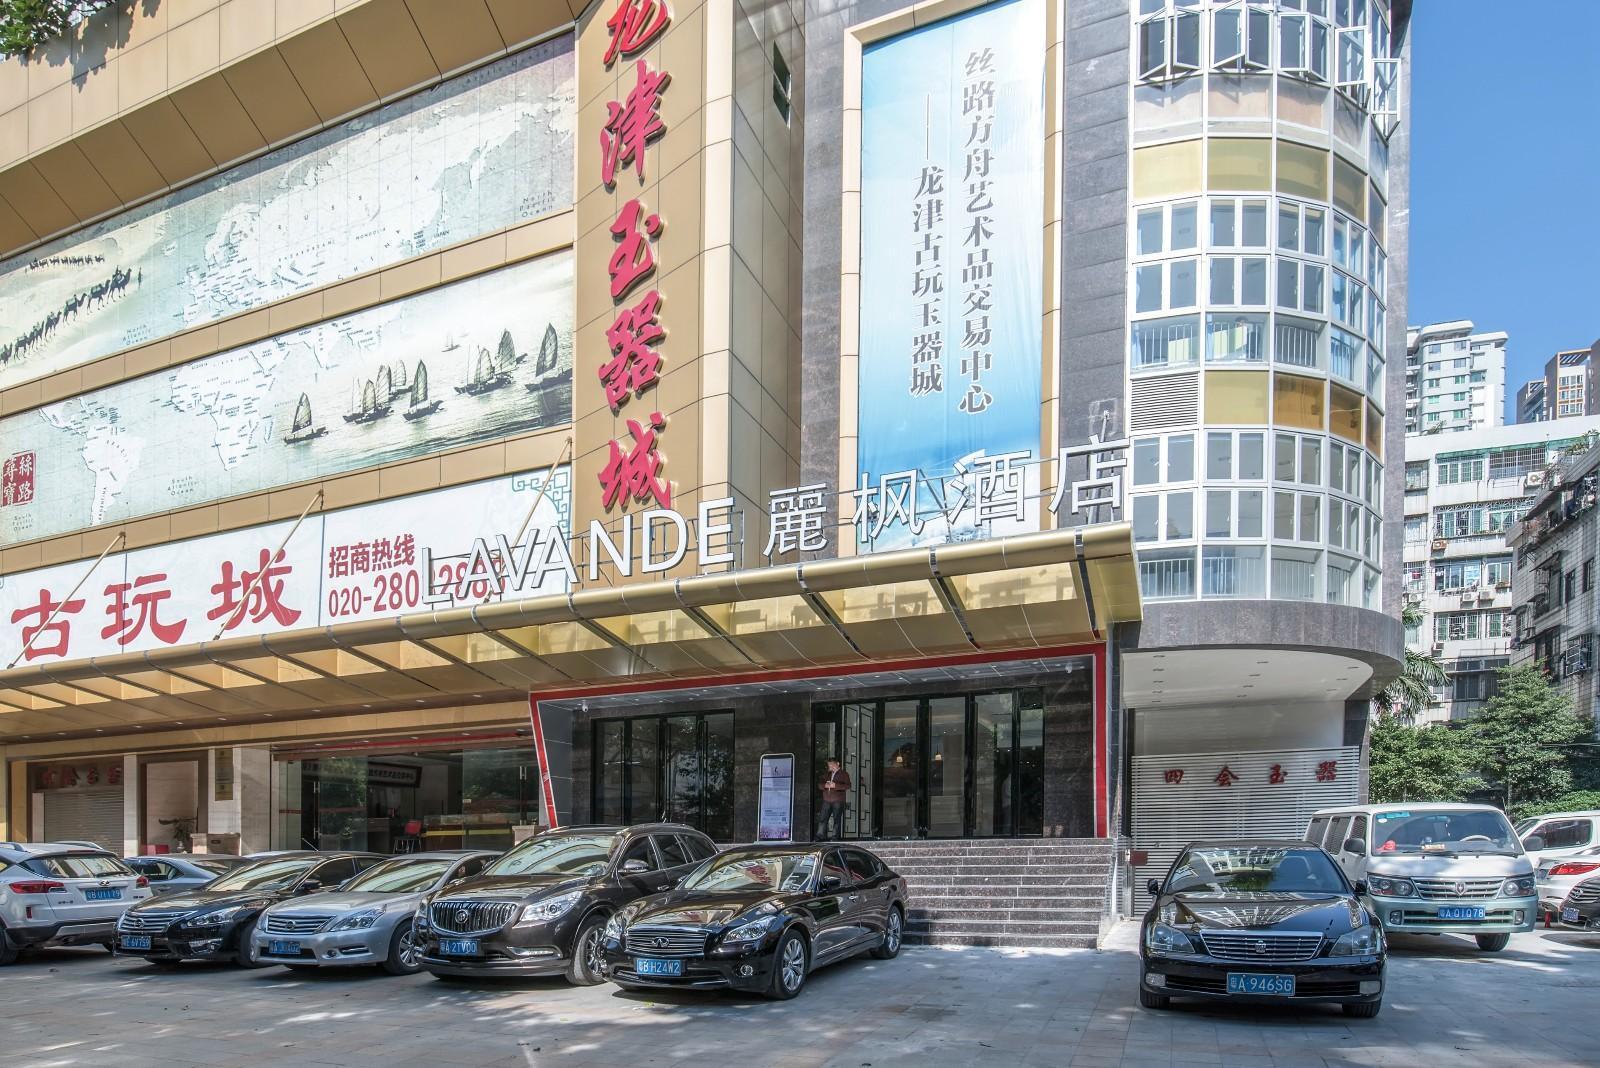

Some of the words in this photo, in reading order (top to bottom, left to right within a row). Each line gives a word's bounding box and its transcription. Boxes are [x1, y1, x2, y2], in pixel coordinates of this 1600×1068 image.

[959, 46, 996, 415] 丝路方舟艺术品交易中心
[328, 533, 416, 579] 招商热线
[421, 496, 736, 605] LAVANDE
[763, 433, 1130, 559] 麗枫酒店
[10, 547, 302, 662] 古玩城
[1163, 760, 1339, 788] 四会玉器
